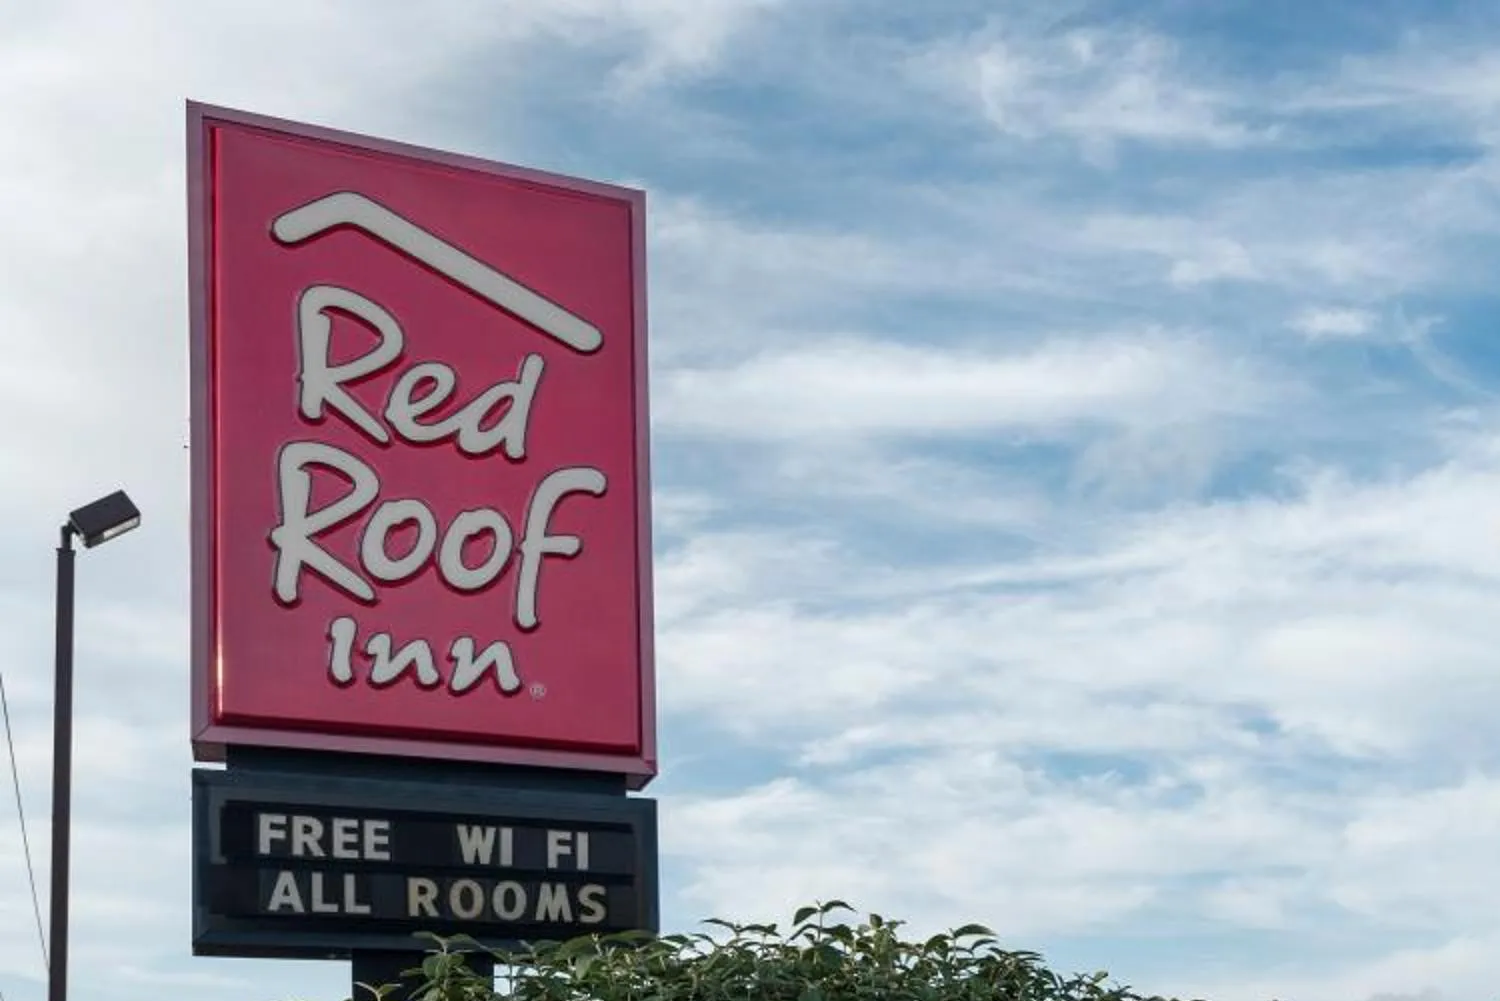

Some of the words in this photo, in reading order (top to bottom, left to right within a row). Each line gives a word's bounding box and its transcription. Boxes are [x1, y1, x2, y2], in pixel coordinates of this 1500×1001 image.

[296, 284, 544, 462] Red
[269, 441, 608, 630] Roof
[258, 813, 391, 862] FREE
[457, 824, 514, 867] WI
[546, 830, 590, 871] FI
[268, 870, 371, 914] ALL
[408, 877, 608, 924] ROOMS
